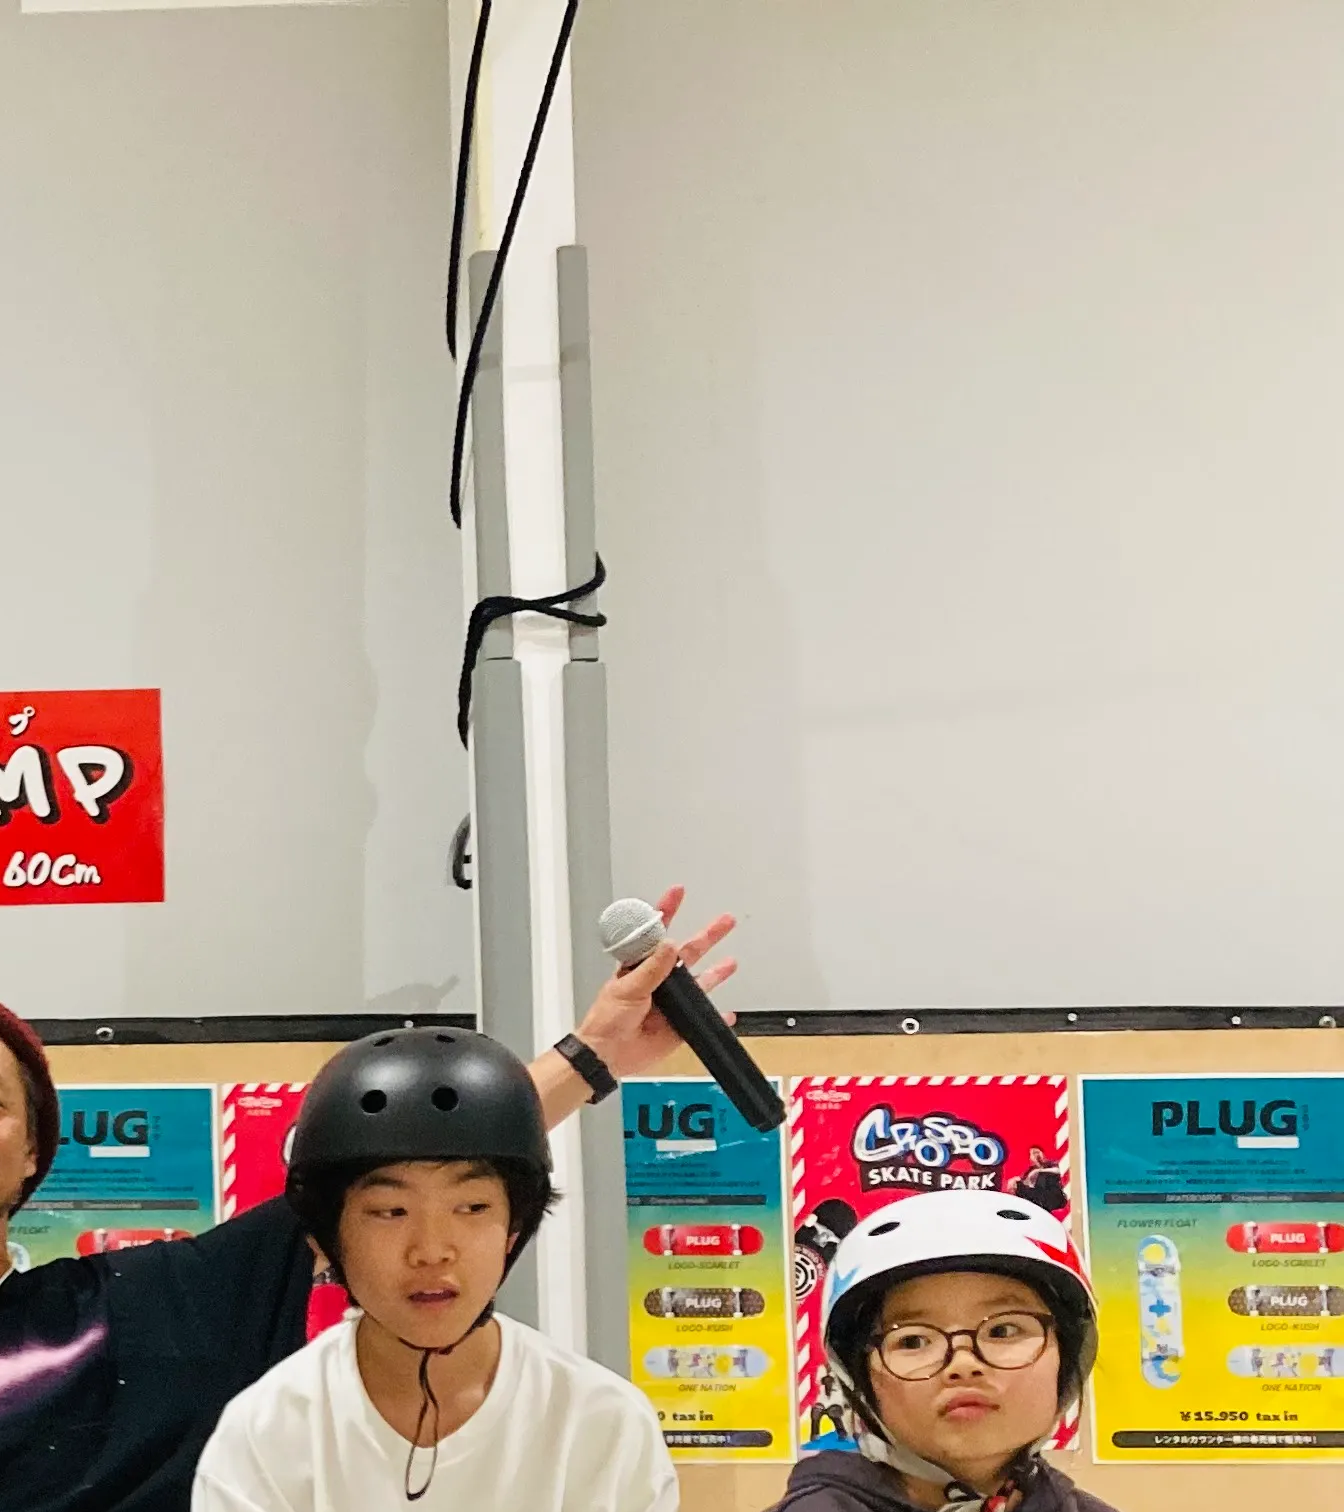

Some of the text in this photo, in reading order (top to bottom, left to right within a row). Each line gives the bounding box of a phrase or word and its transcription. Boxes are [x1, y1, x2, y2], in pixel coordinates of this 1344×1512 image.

[624, 1103, 715, 1139] UG
[1152, 1099, 1298, 1136] PLUG
[59, 1110, 149, 1146] UG
[868, 1166, 997, 1190] SKATE PARK
[1117, 1218, 1199, 1228] FLOWER FLOAT
[686, 1235, 721, 1246] PLUG
[1270, 1232, 1306, 1244] PLUG
[685, 1298, 722, 1310] PLUG
[1270, 1295, 1309, 1307] PLUG
[672, 1411, 696, 1422] tax
[700, 1410, 715, 1422] in
[1256, 1412, 1280, 1422] tax
[1283, 1410, 1299, 1421] in
